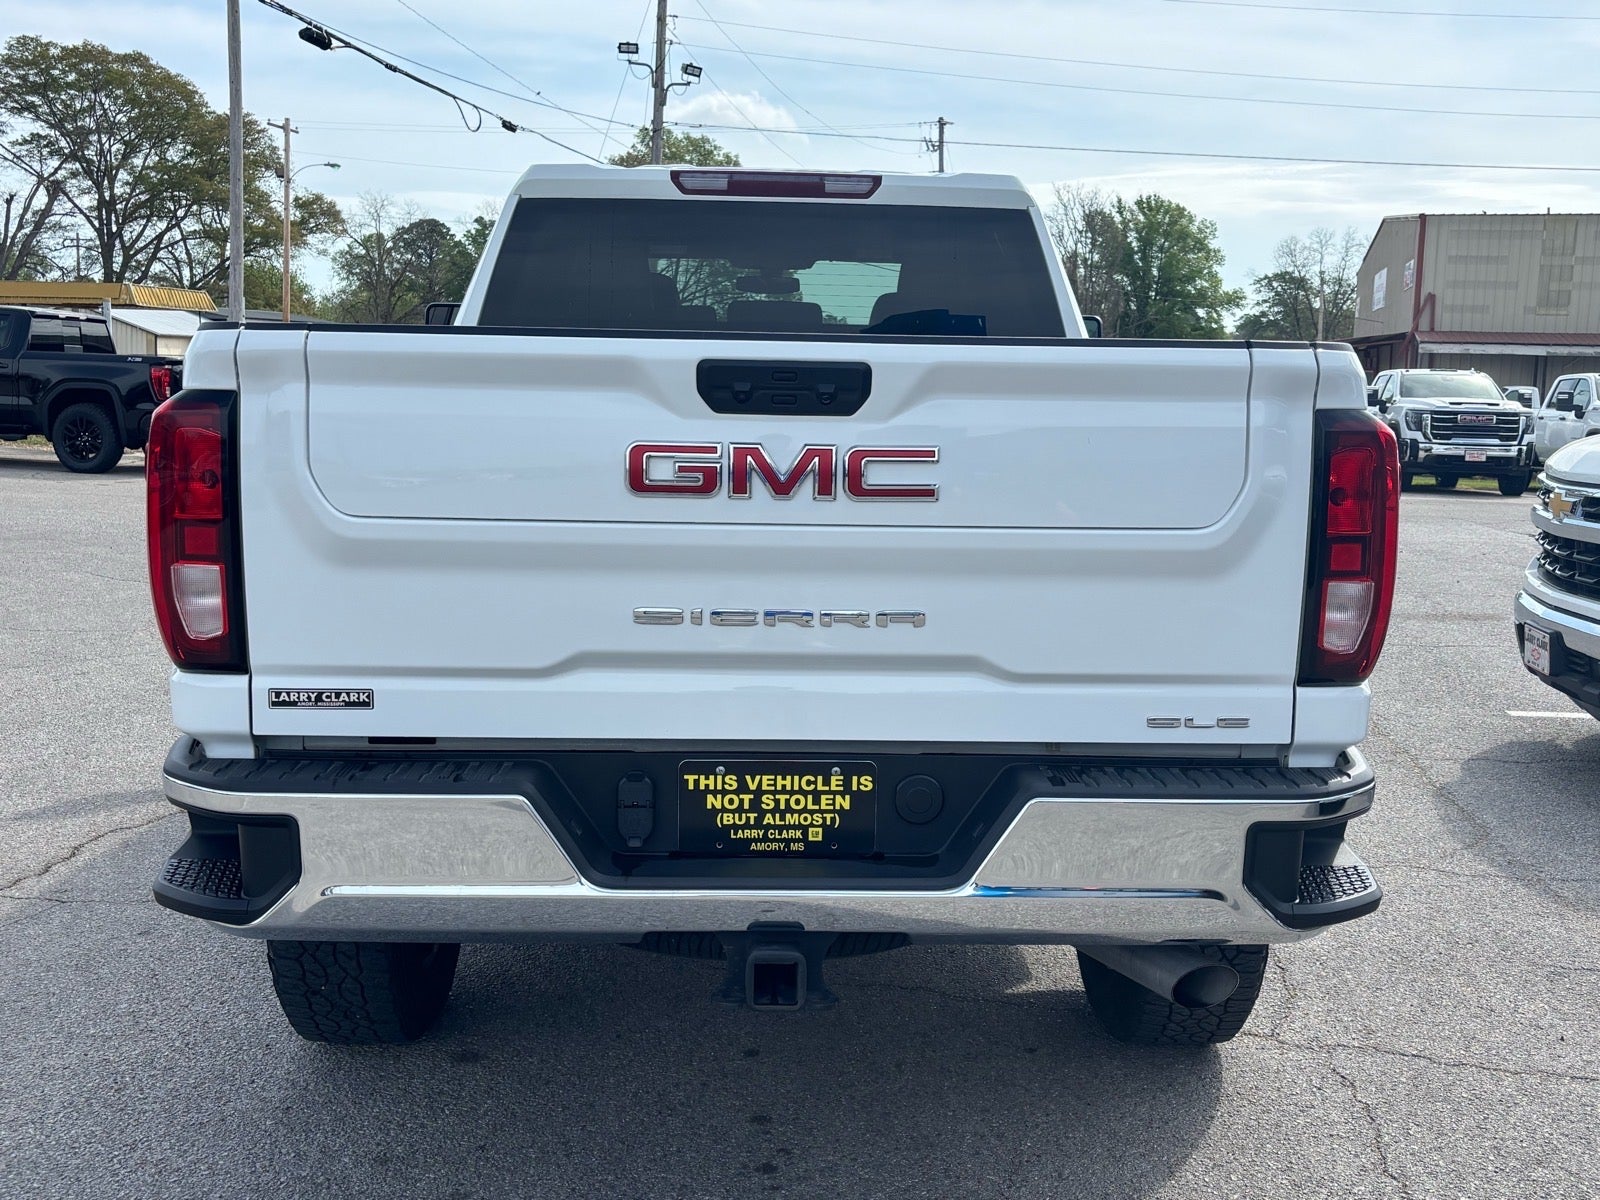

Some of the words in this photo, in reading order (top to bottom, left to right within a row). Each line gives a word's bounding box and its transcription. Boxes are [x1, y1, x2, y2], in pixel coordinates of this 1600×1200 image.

[624, 440, 940, 502] GMC
[632, 606, 927, 628] SIERRA
[271, 692, 318, 702] LARRY
[321, 692, 370, 702] CLARK
[1146, 716, 1250, 728] SLE
[683, 774, 738, 791] THIS
[745, 775, 844, 791] VEHICLE
[852, 776, 873, 791] IS
[706, 794, 754, 810] NOT
[761, 794, 851, 810] STOLEN
[716, 813, 758, 828] (BUT
[763, 813, 840, 829] ALMOST)
[730, 829, 765, 839] LARRY
[768, 829, 803, 839] CLARK
[750, 842, 788, 852] AMORY,
[790, 842, 805, 851] MS
